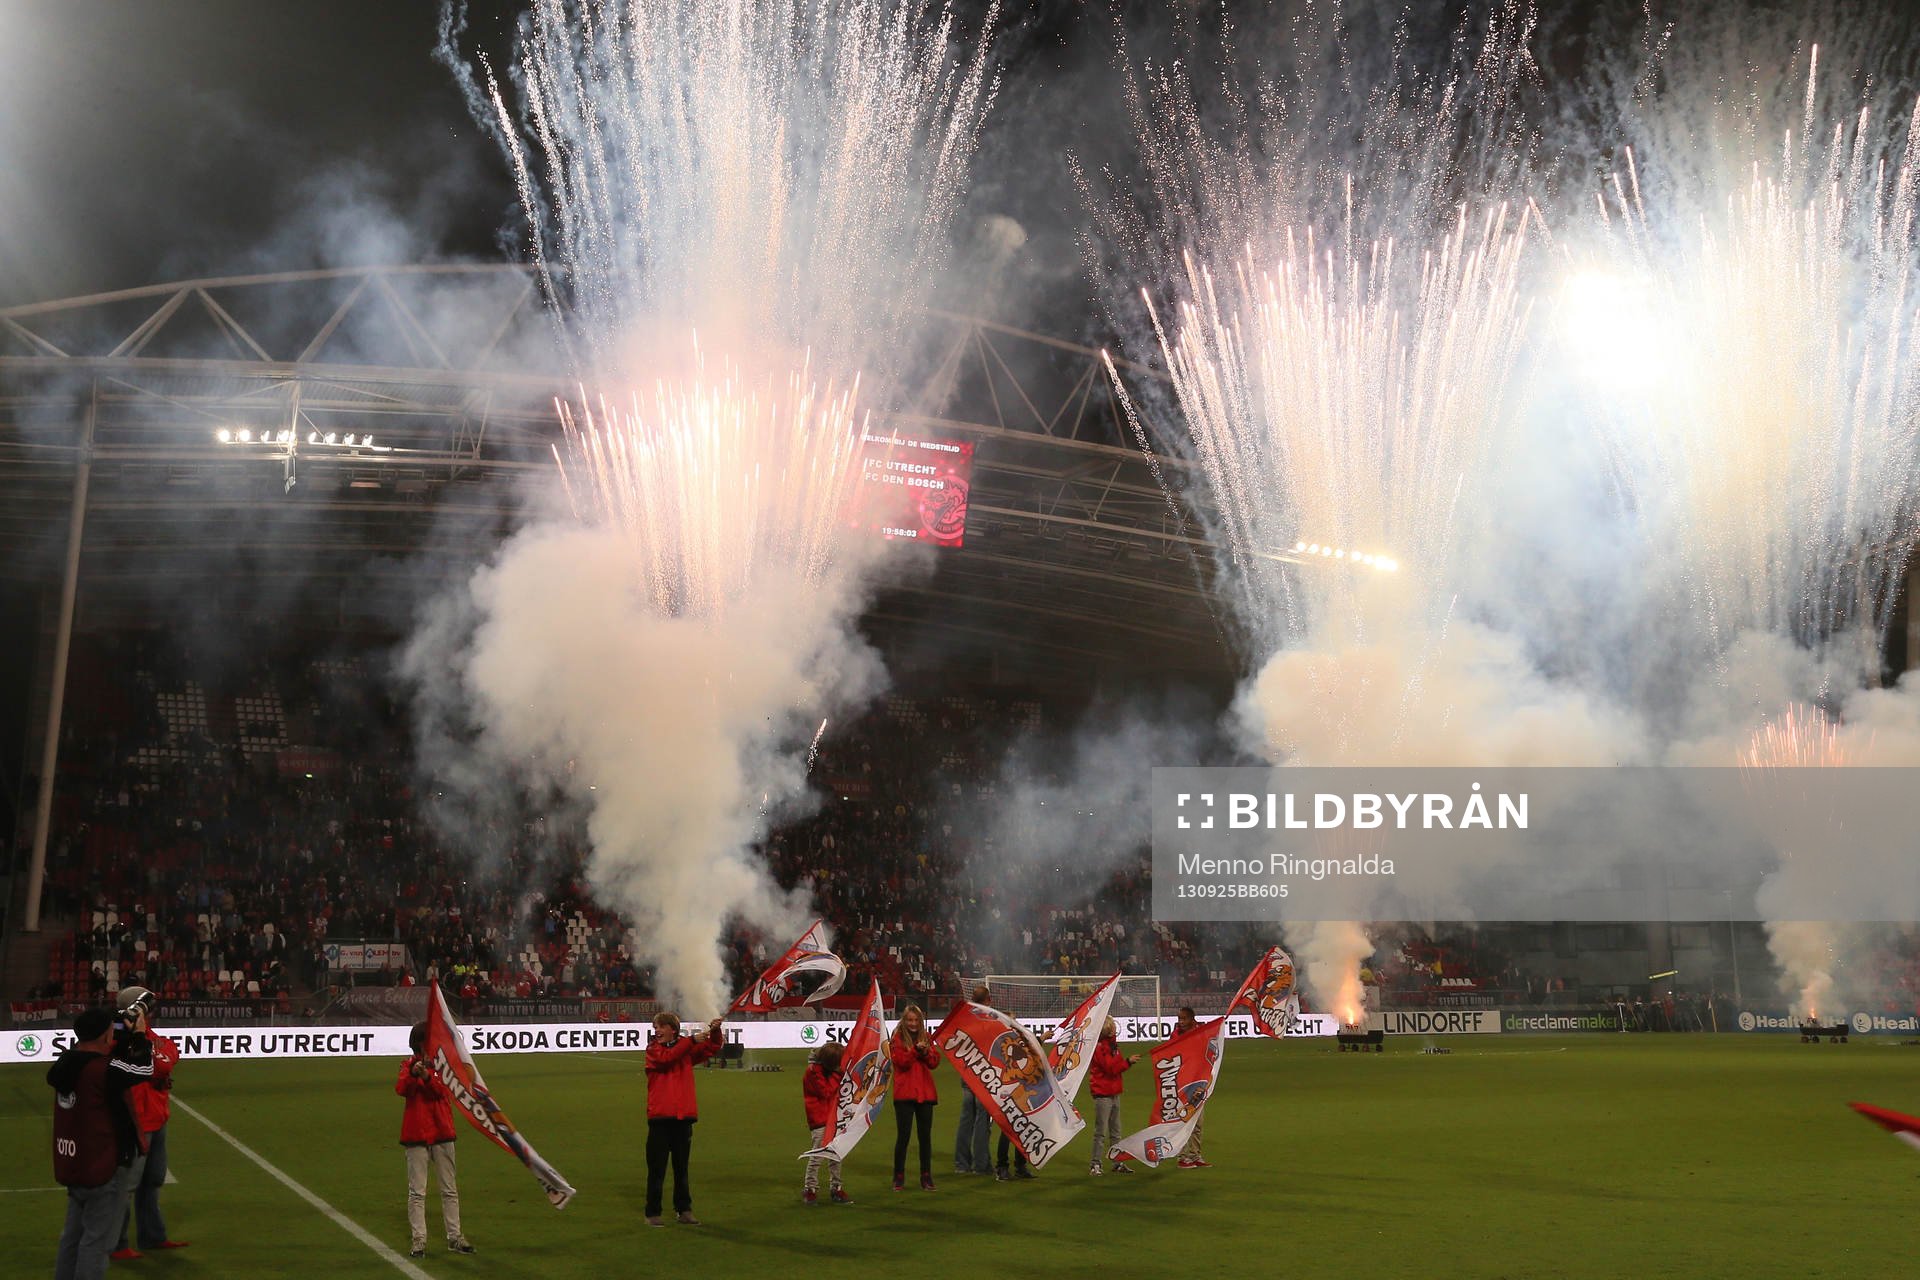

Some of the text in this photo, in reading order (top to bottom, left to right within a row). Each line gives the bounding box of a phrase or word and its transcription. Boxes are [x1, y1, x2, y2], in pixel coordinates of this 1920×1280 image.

[869, 458, 936, 475] FC UTRECHT
[865, 472, 944, 490] FC DEN BOSCH
[160, 1006, 191, 1018] DAVE
[1126, 1019, 1178, 1038] ŠKOD
[1384, 1012, 1483, 1033] LINDORFF
[159, 1034, 374, 1054] ENTER UTRECHT
[472, 1027, 549, 1050] ŠKODA
[555, 1029, 640, 1048] CENTER
[944, 1028, 1002, 1094] JUNIOR
[1000, 1097, 1057, 1166] TIGERS
[1155, 1053, 1182, 1122] JUNIOR
[57, 1138, 77, 1157] OTO
